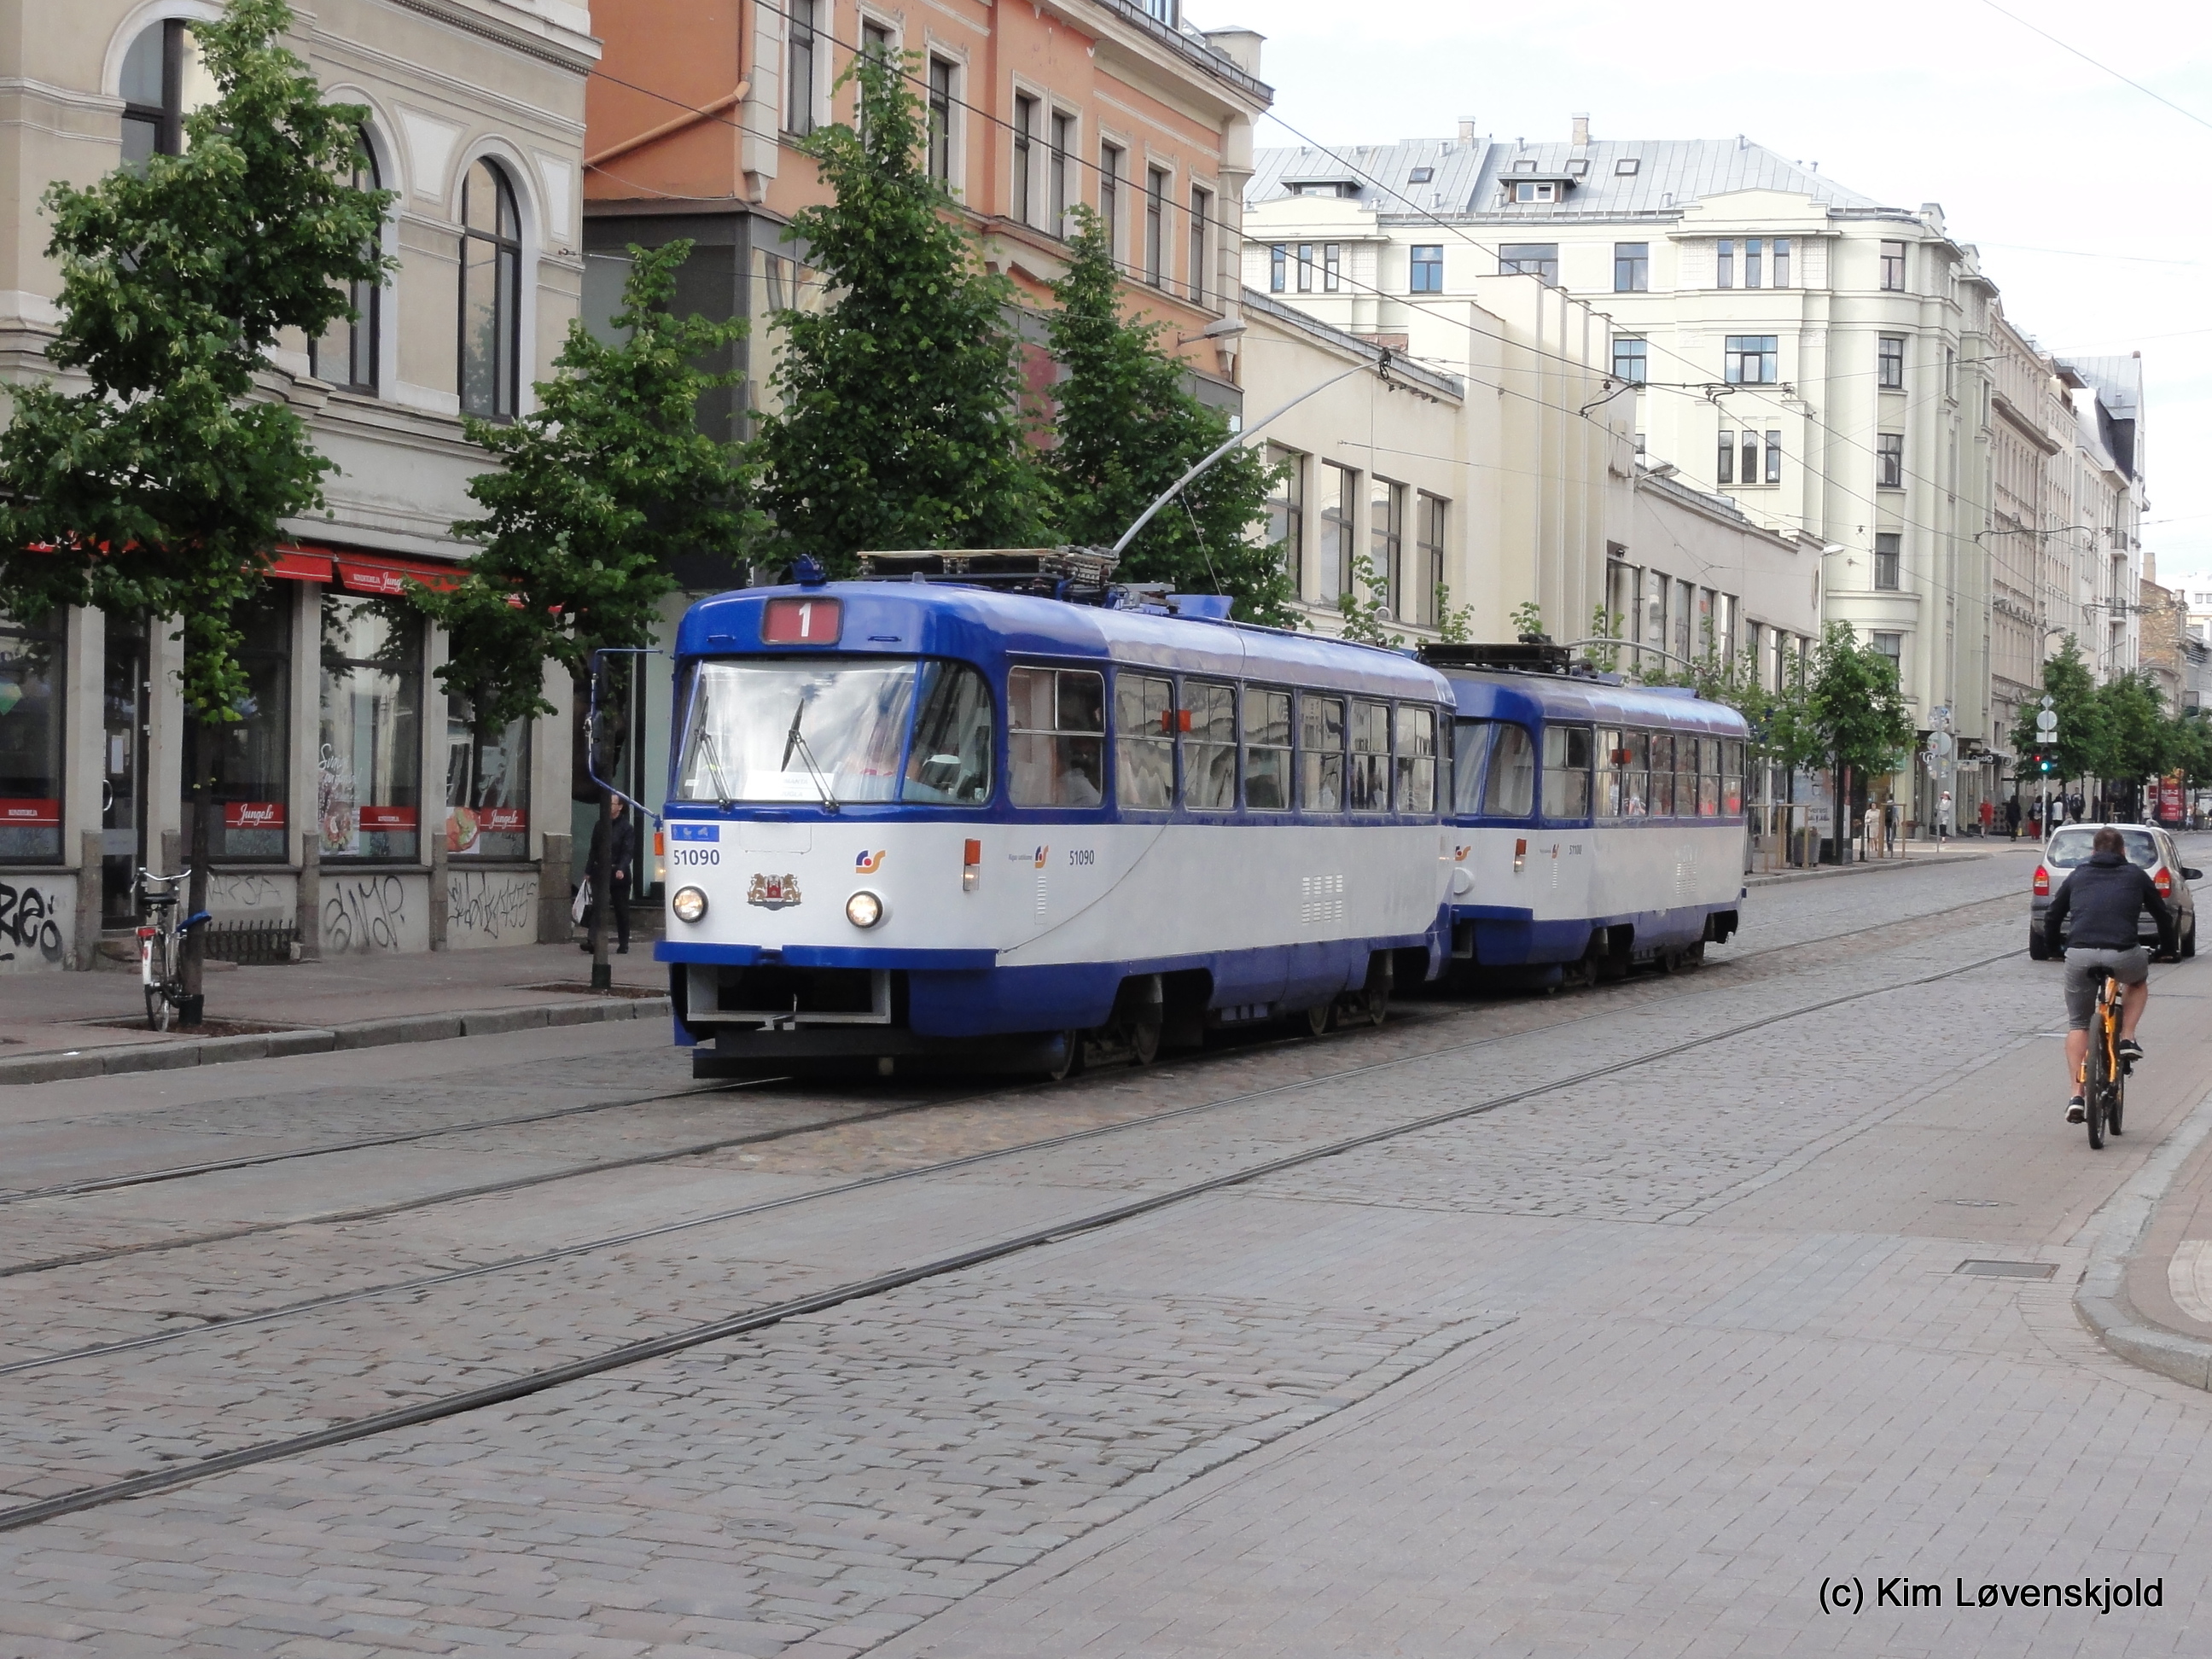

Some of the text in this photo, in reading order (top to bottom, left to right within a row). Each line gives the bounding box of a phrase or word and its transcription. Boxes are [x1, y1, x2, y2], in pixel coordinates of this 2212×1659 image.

[798, 602, 812, 637] 1
[673, 849, 720, 865] 51090
[1069, 850, 1095, 865] 51090
